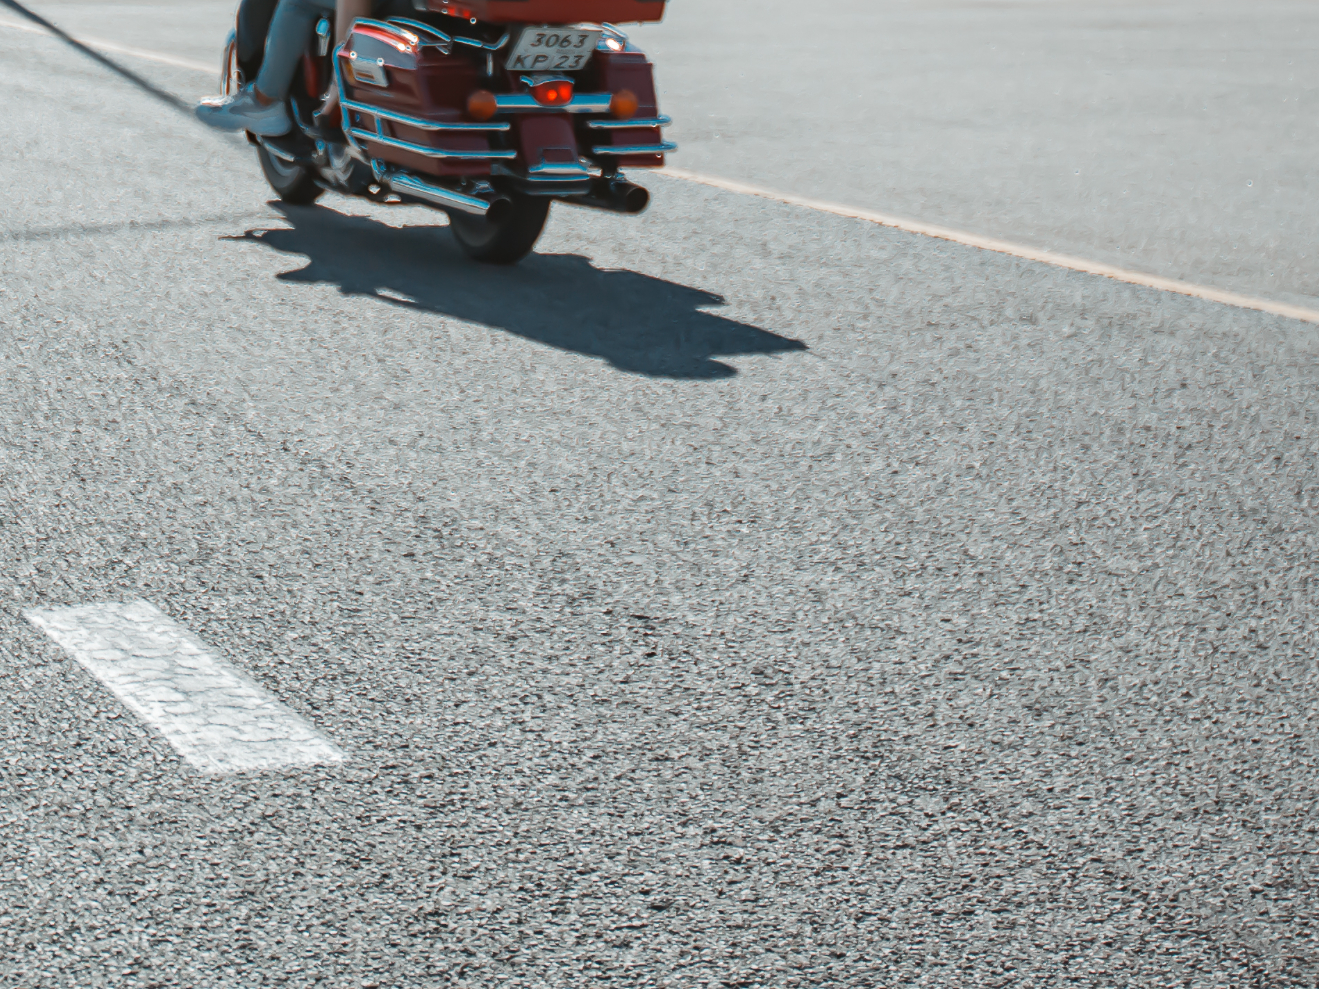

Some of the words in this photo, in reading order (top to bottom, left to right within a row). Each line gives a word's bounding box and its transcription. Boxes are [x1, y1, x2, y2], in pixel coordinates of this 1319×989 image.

[530, 33, 589, 48] 3063
[513, 54, 548, 68] KP
[553, 55, 584, 68] 23
